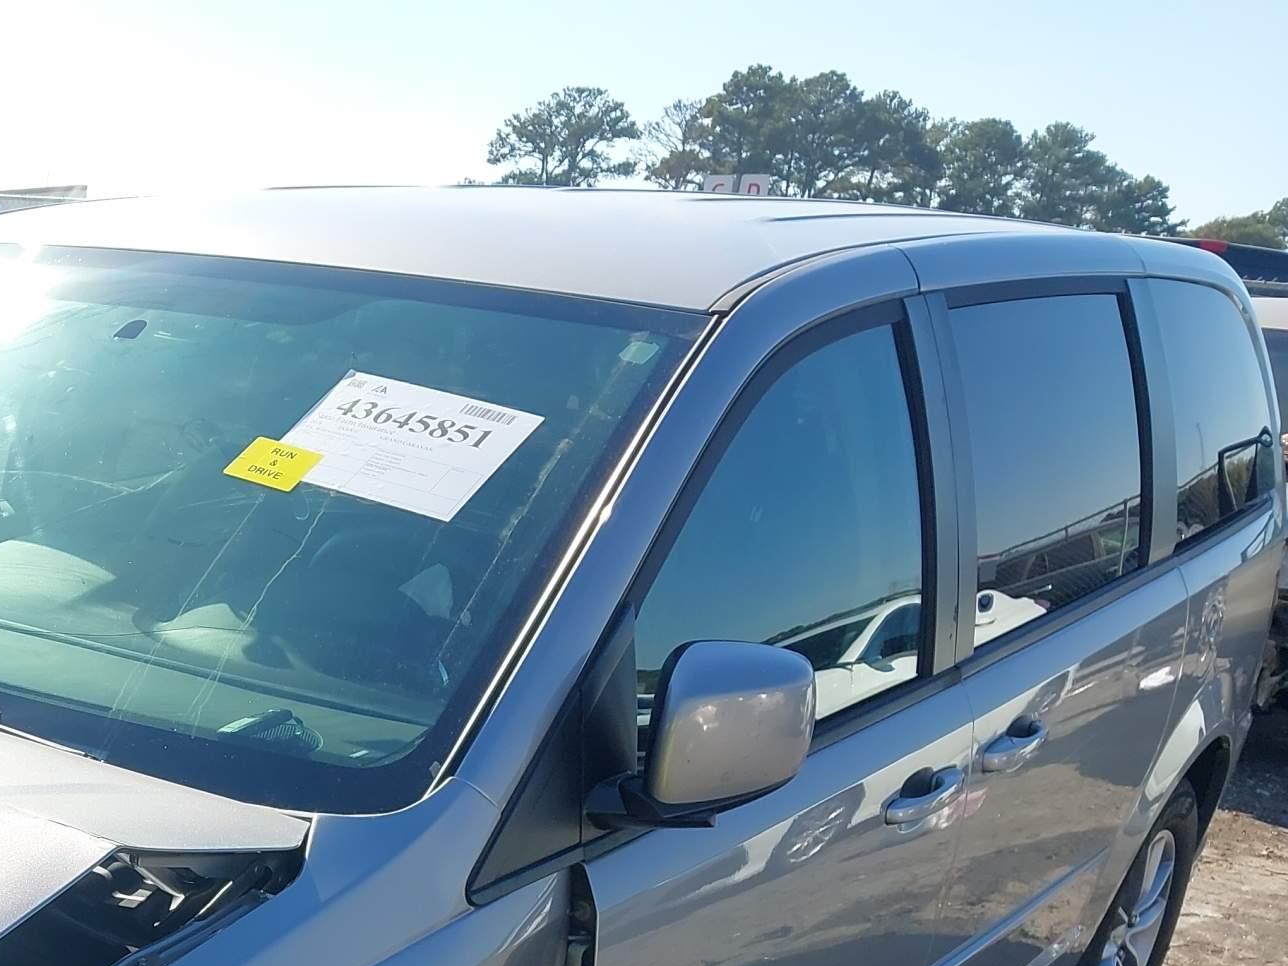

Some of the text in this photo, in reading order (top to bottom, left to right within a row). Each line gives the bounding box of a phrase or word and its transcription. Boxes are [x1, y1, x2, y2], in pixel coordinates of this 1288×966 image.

[336, 398, 492, 449] 43645851
[271, 447, 297, 460] RUN
[269, 459, 279, 467] &
[247, 464, 284, 480] DRIVE
